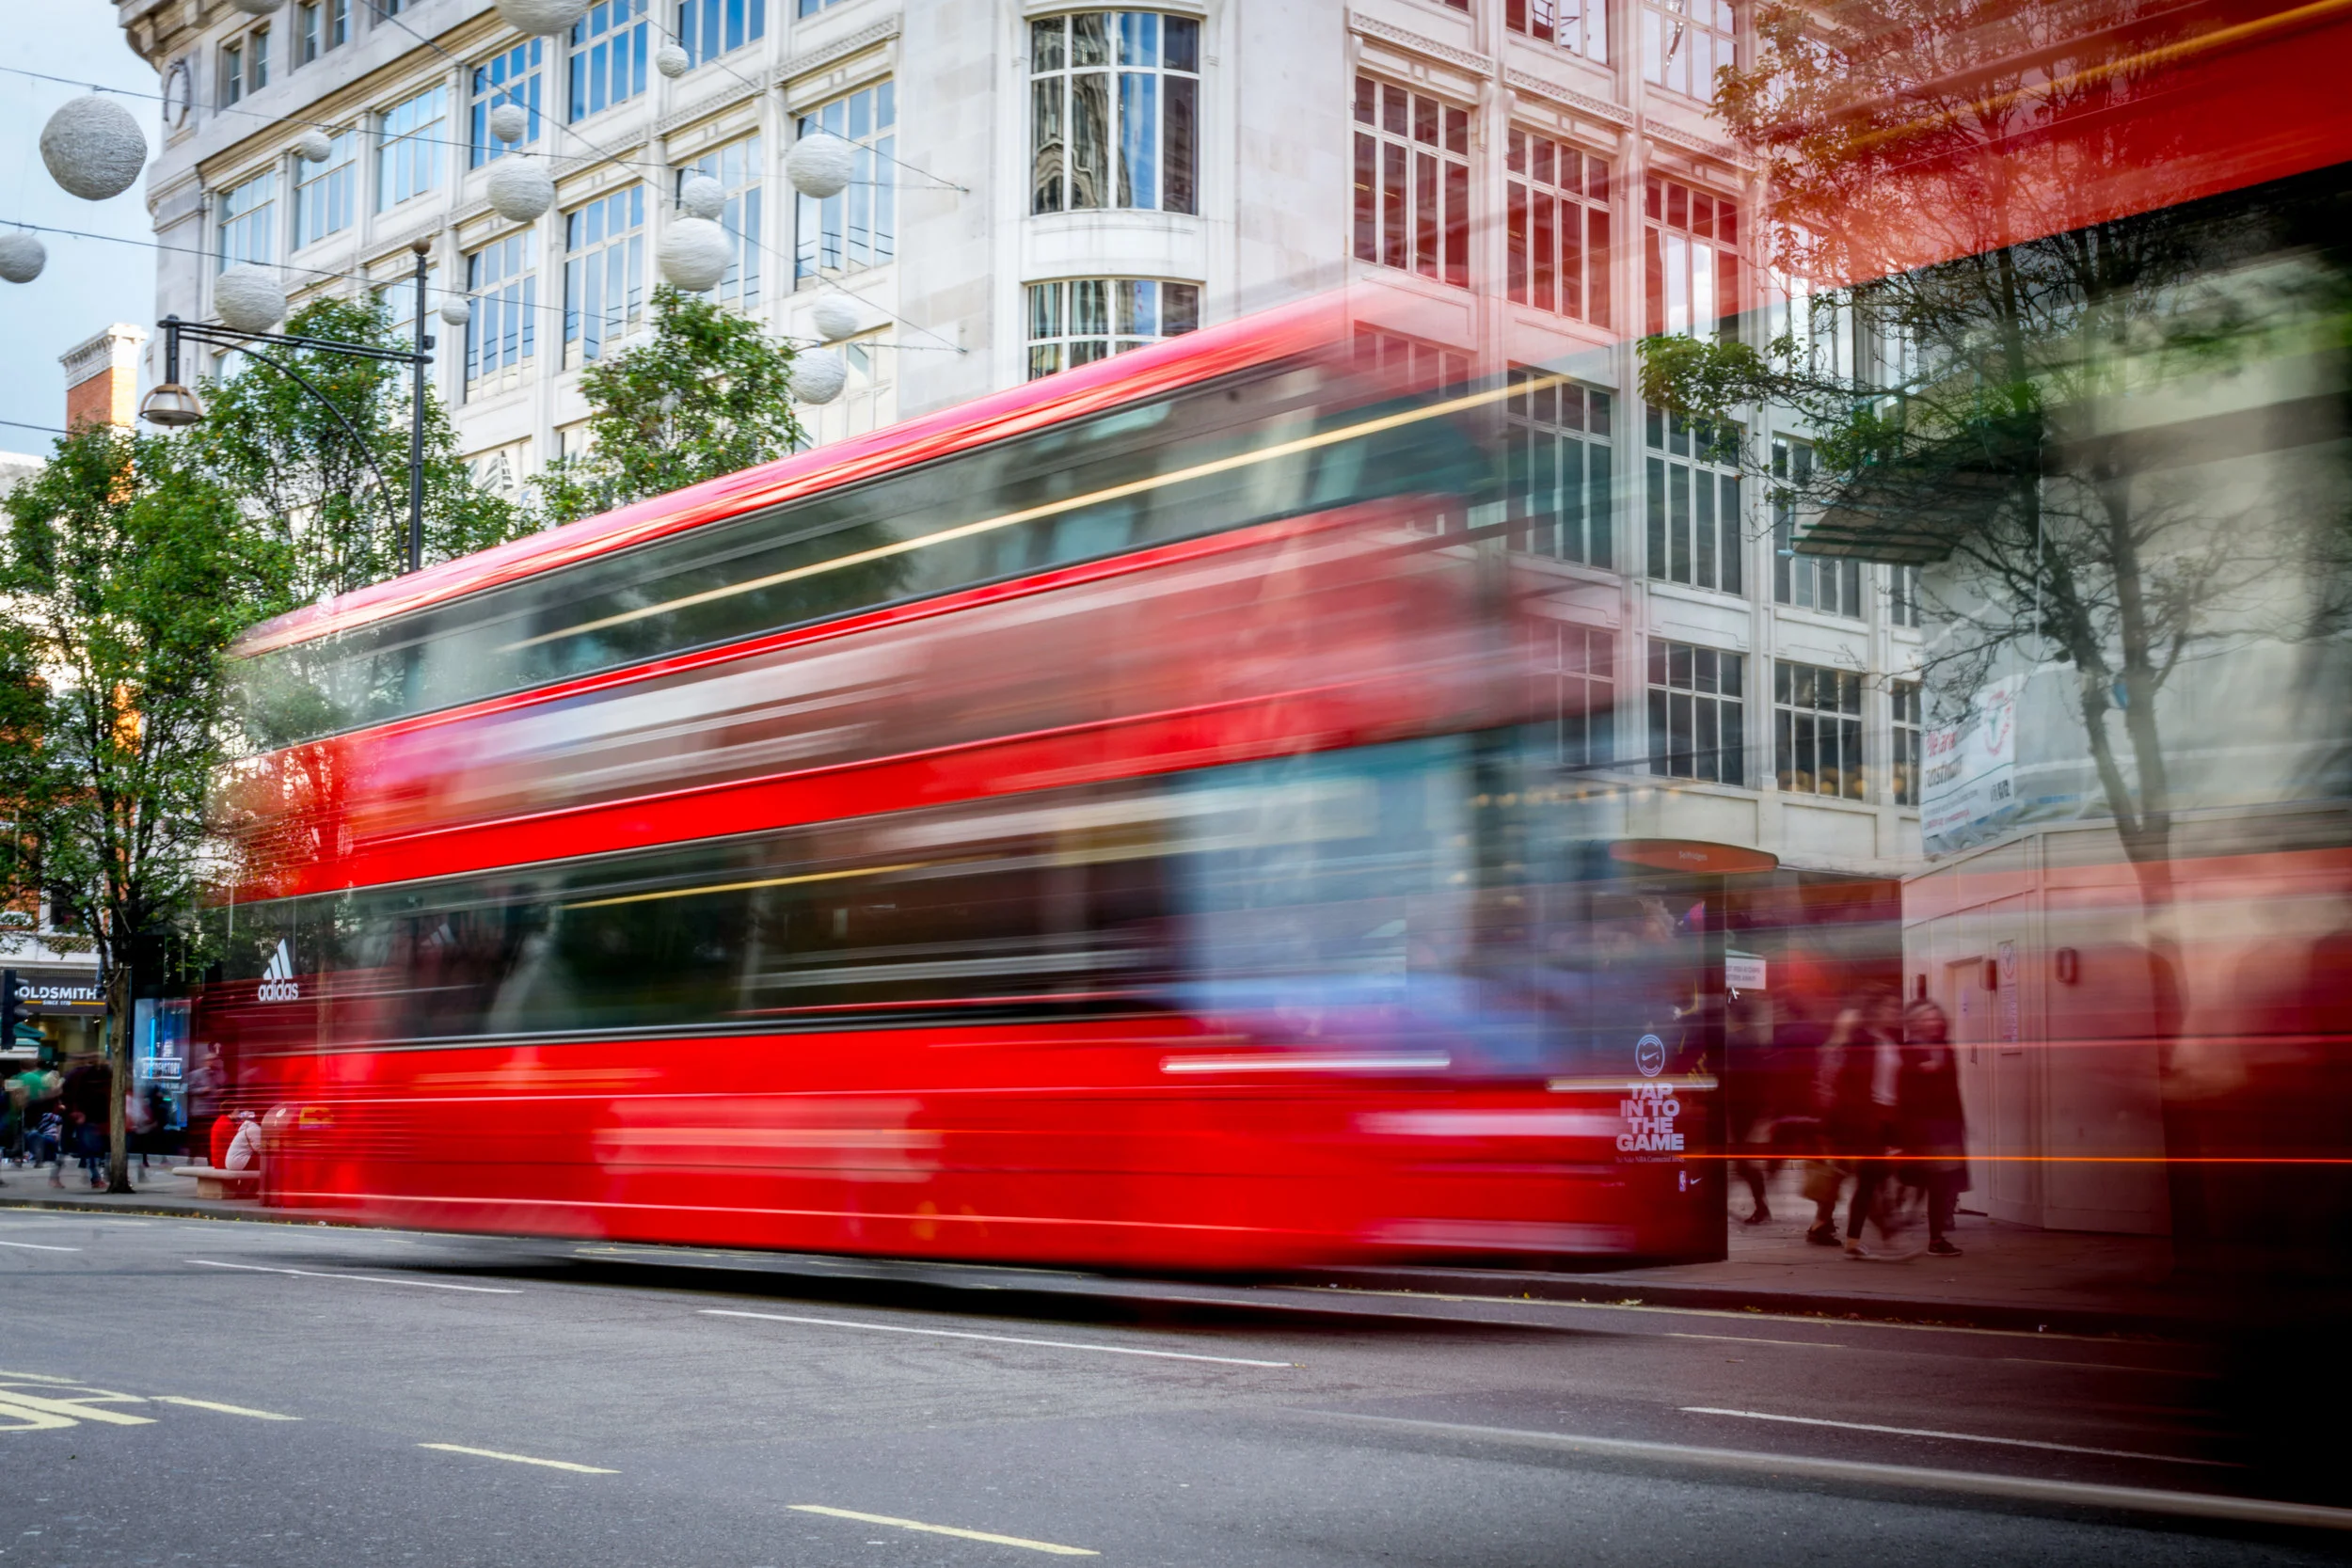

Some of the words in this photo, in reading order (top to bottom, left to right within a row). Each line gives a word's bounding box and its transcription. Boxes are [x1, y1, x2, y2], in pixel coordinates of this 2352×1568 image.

[14, 986, 103, 1000] OLDSMITH
[258, 978, 299, 1003] adidas
[1627, 1083, 1674, 1100] TAP
[1620, 1100, 1645, 1117] IN
[1648, 1100, 1680, 1117] TO
[1628, 1117, 1674, 1134] THE
[1616, 1133, 1684, 1151] GAME
